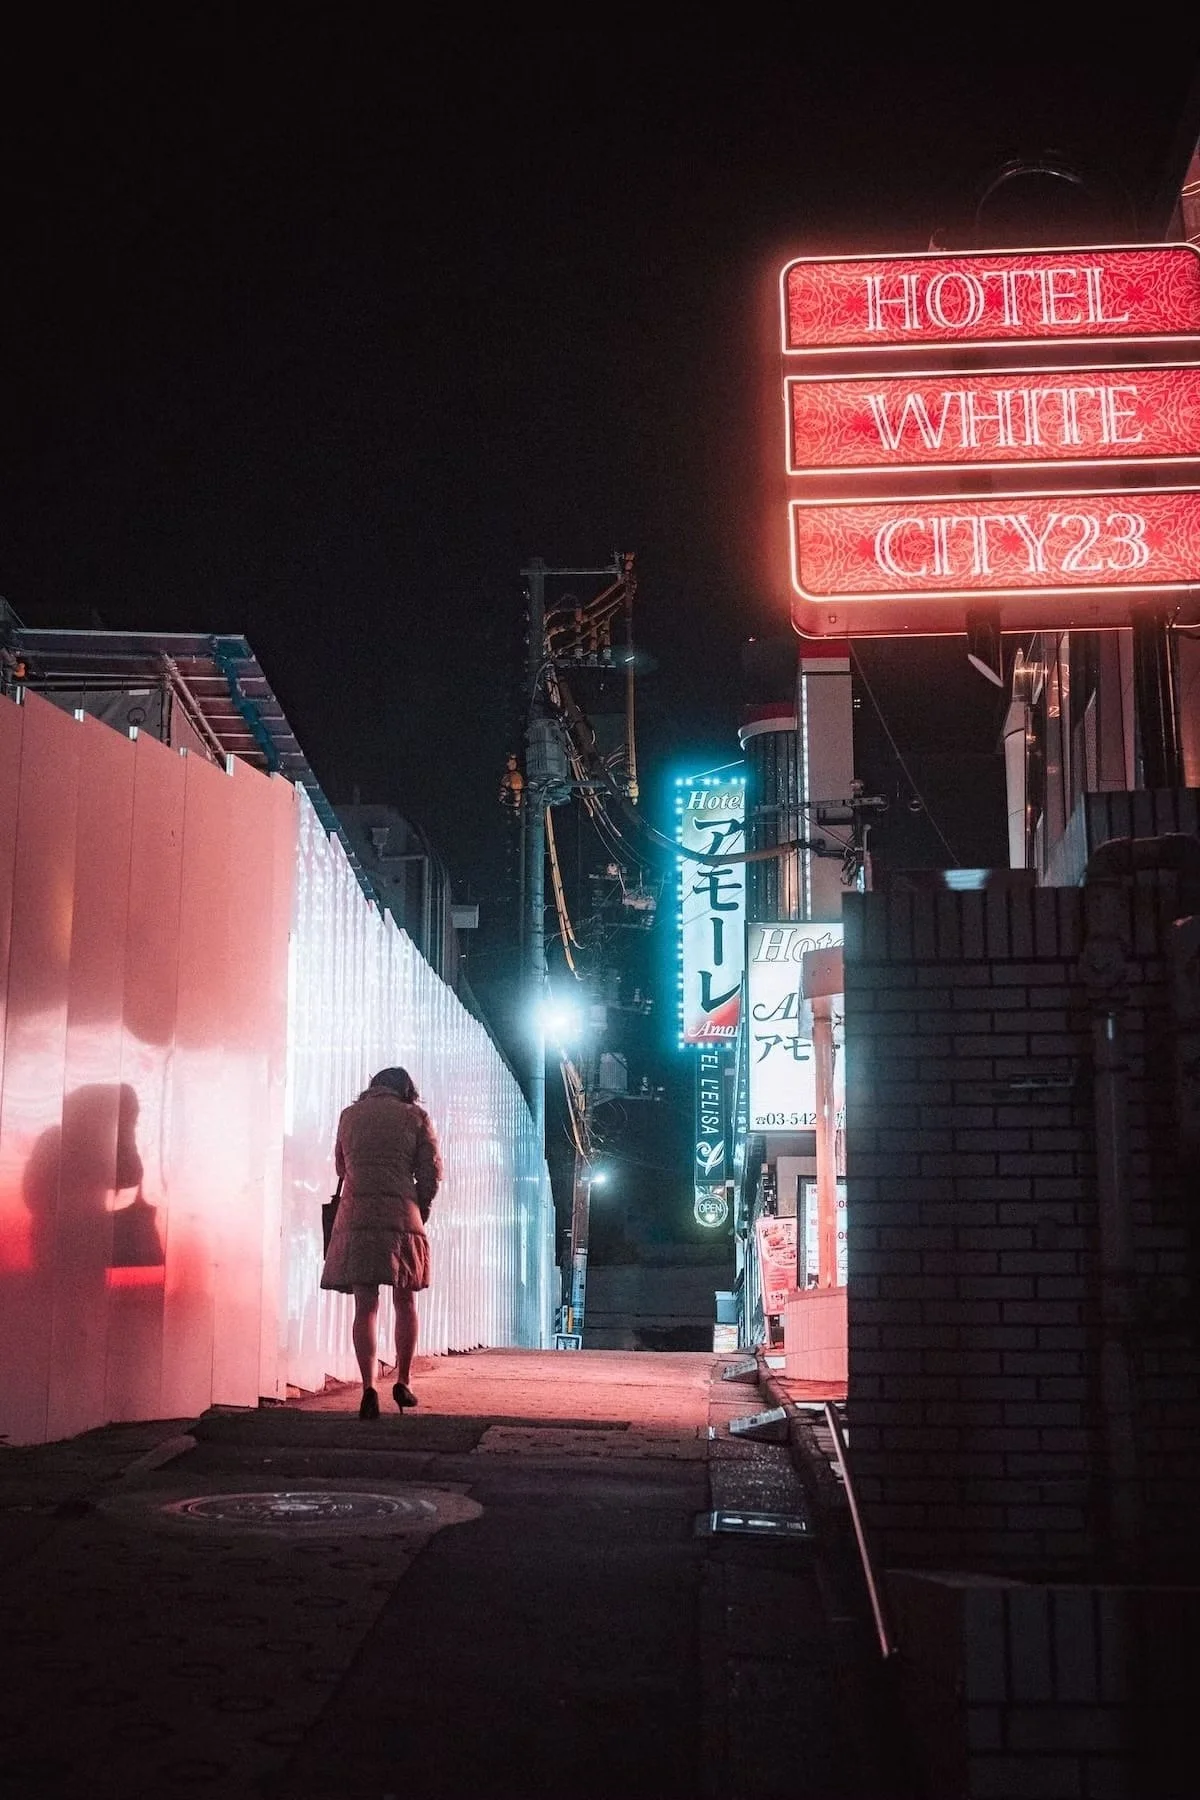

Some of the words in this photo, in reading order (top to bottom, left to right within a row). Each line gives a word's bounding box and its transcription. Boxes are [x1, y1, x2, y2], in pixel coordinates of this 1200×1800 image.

[865, 267, 1129, 331] HOTEL
[865, 386, 1144, 450] WHITE
[873, 512, 1151, 577] CITY23
[692, 817, 745, 1013] アモーレ
[752, 992, 799, 1021] A
[754, 1034, 813, 1063] アモ
[699, 1202, 724, 1214] OPEN
